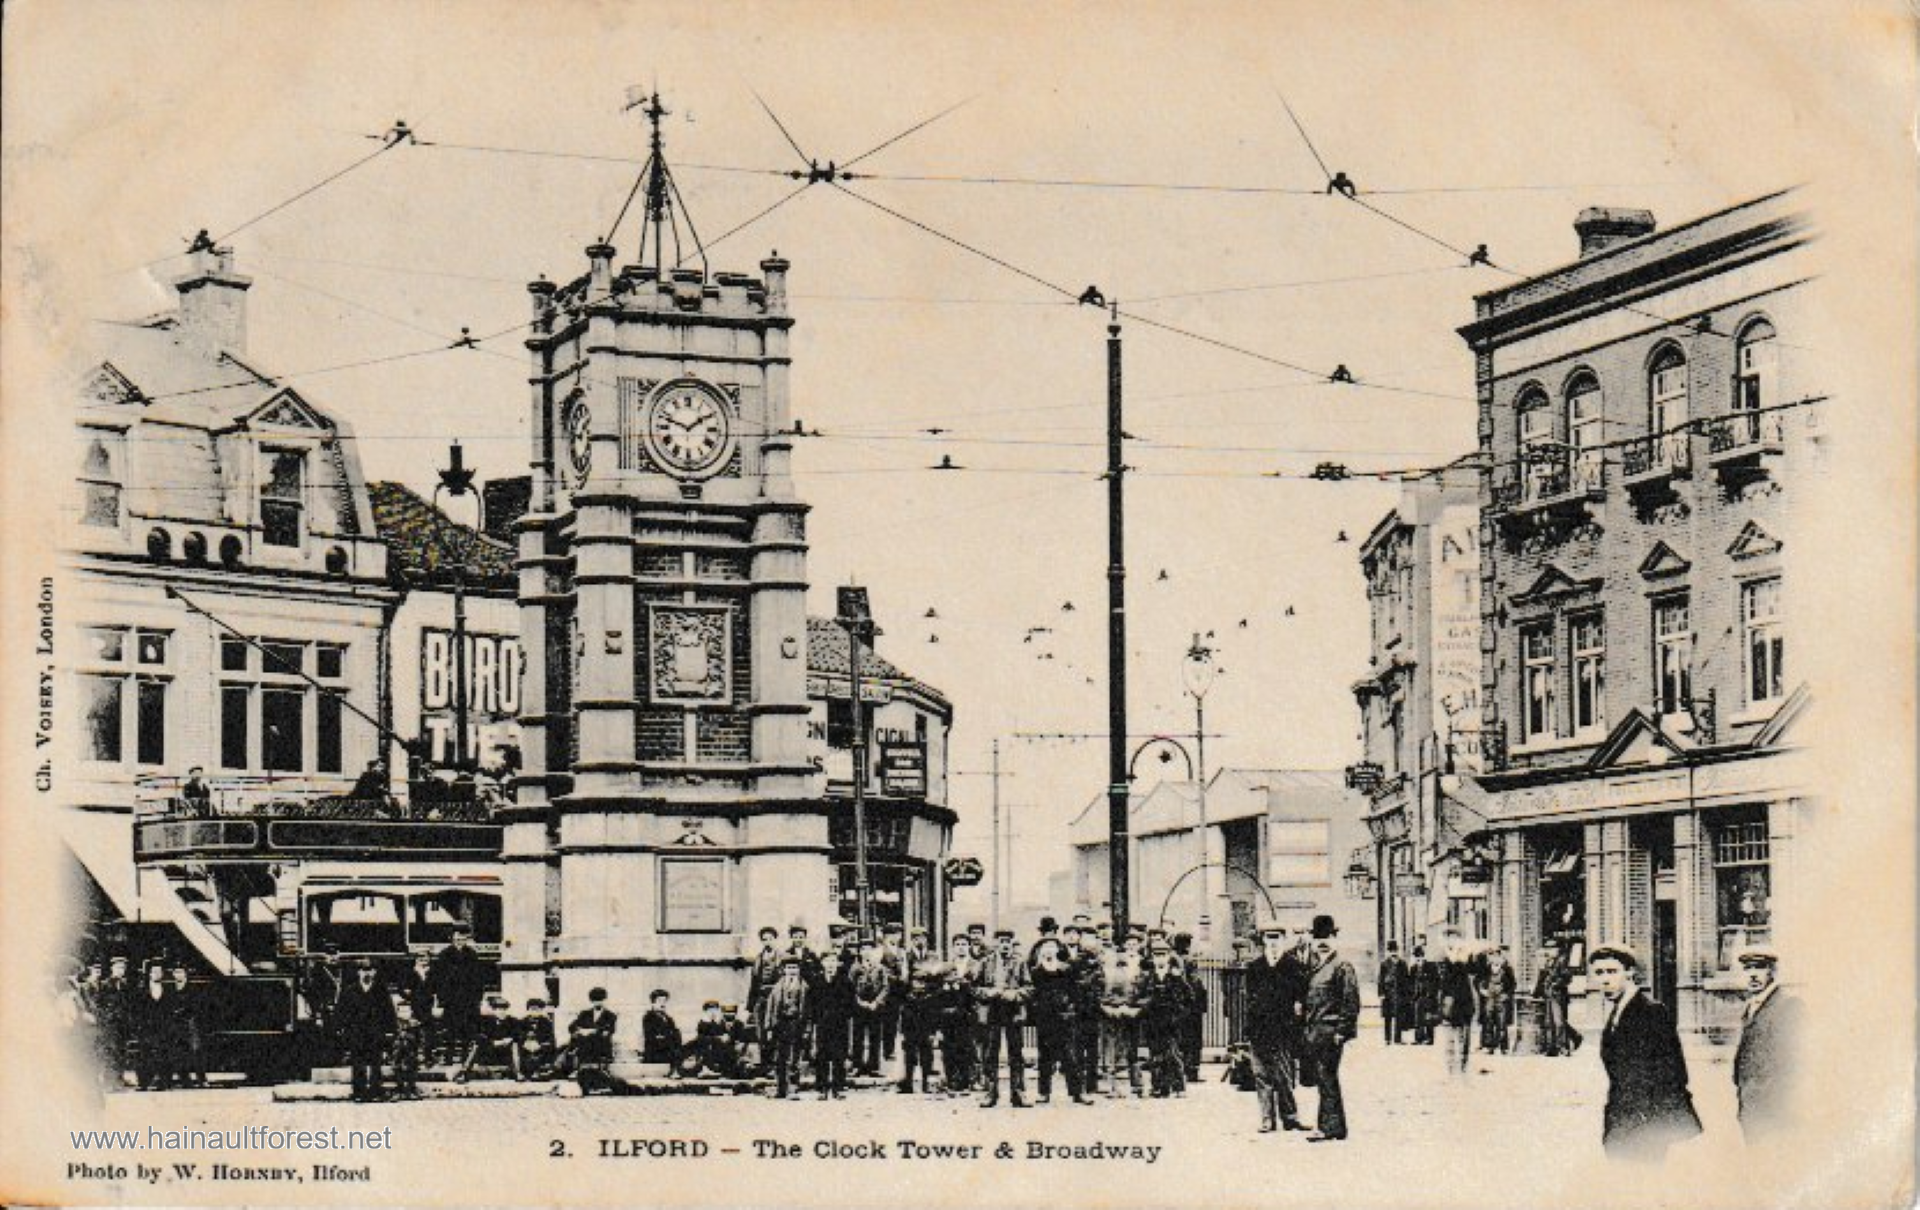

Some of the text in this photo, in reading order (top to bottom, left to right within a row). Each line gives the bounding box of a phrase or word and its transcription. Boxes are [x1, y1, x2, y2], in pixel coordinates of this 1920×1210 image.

[36, 577, 53, 654] London
[36, 759, 51, 792] Ch.
[549, 1139, 573, 1158] 2.
[598, 1139, 709, 1158] ILFORD
[753, 1139, 802, 1159] The
[814, 1139, 886, 1159] Clock
[896, 1140, 982, 1159] Tower
[994, 1141, 1014, 1159] &
[1026, 1140, 1162, 1163] Broadway
[67, 1163, 128, 1180] Photo
[137, 1163, 162, 1184] by
[173, 1164, 202, 1181] W.
[313, 1164, 371, 1182] Ilford
